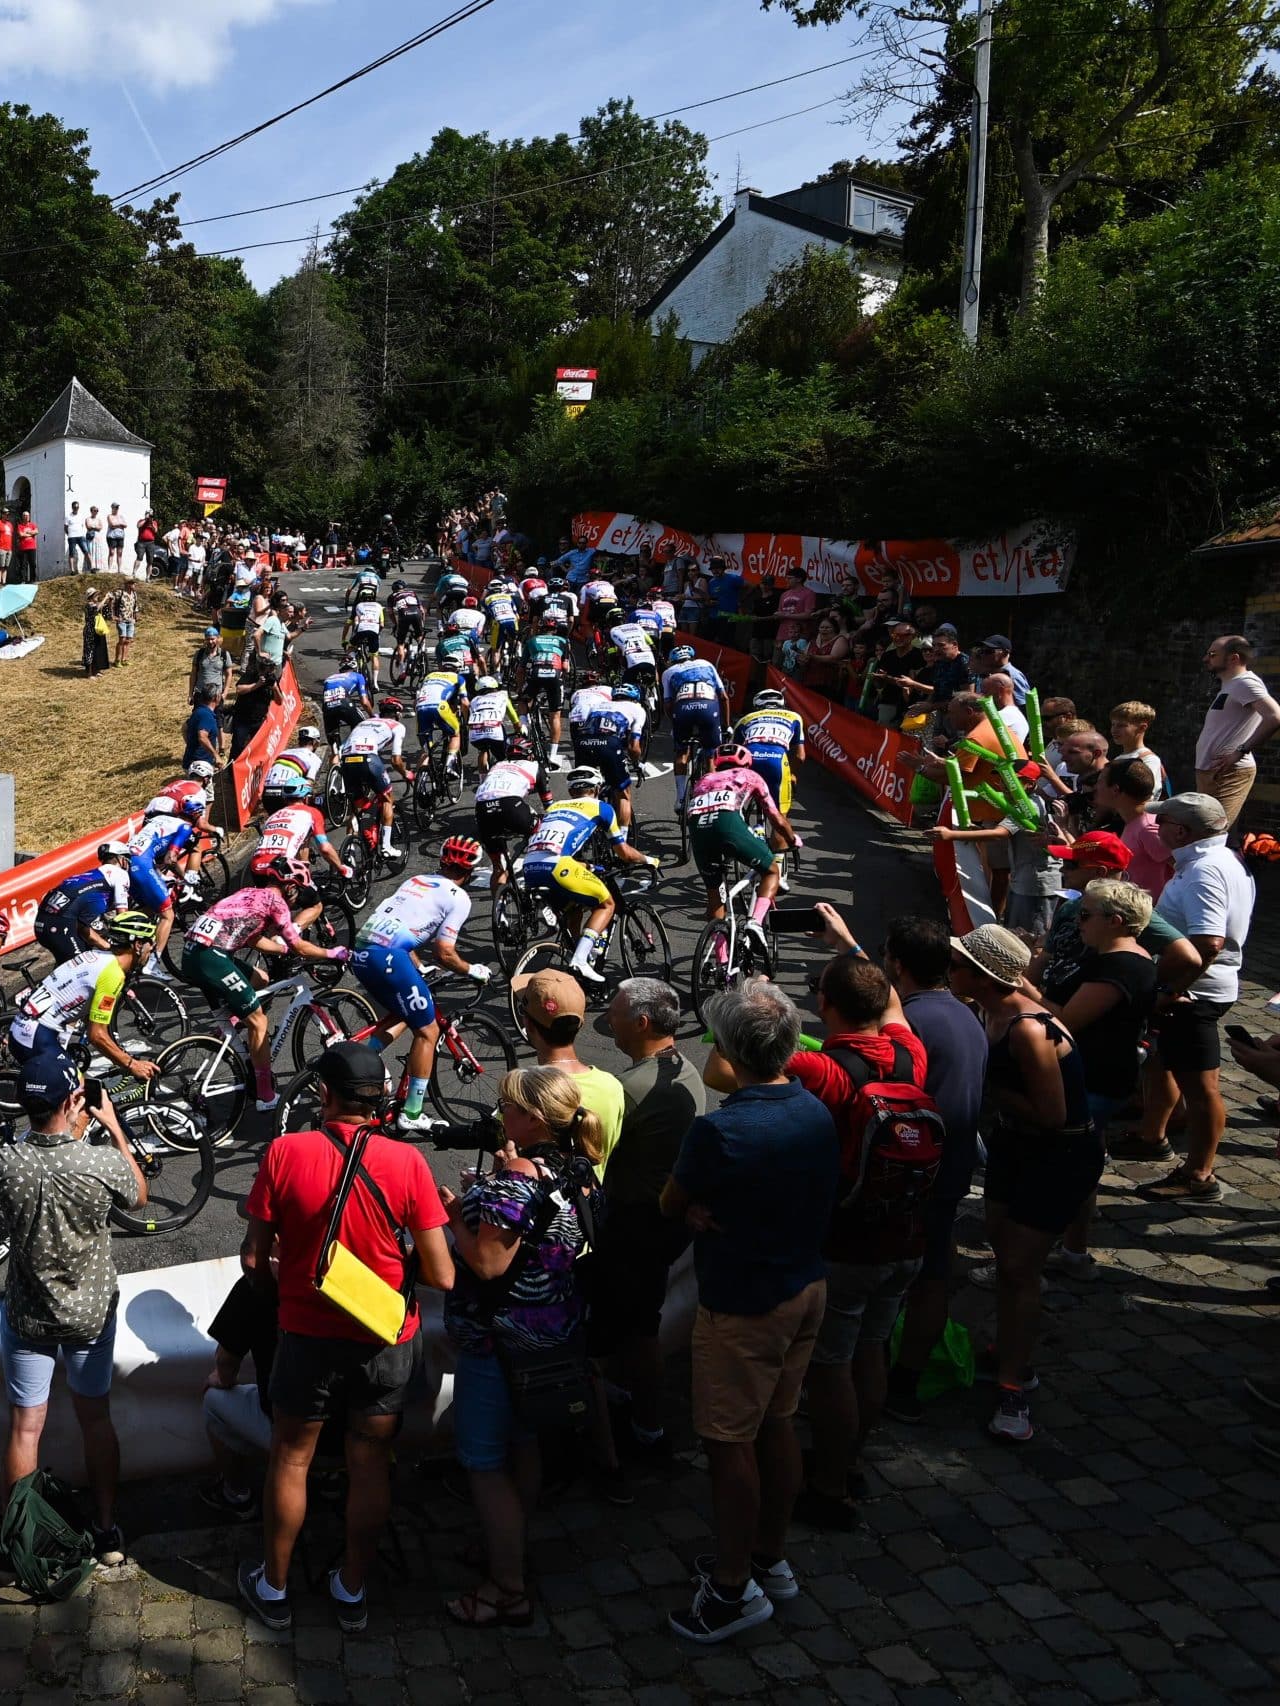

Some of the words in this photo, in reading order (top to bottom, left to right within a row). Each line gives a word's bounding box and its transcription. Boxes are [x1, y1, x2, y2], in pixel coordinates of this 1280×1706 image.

[681, 702, 708, 711] FANTINI
[714, 791, 730, 802] 46
[486, 800, 500, 808] UAE
[698, 812, 719, 825] EF
[271, 836, 284, 846] 93
[198, 917, 217, 935] 45
[221, 971, 247, 993] EF
[163, 987, 189, 1020] roval
[270, 1006, 300, 1063] cannondale
